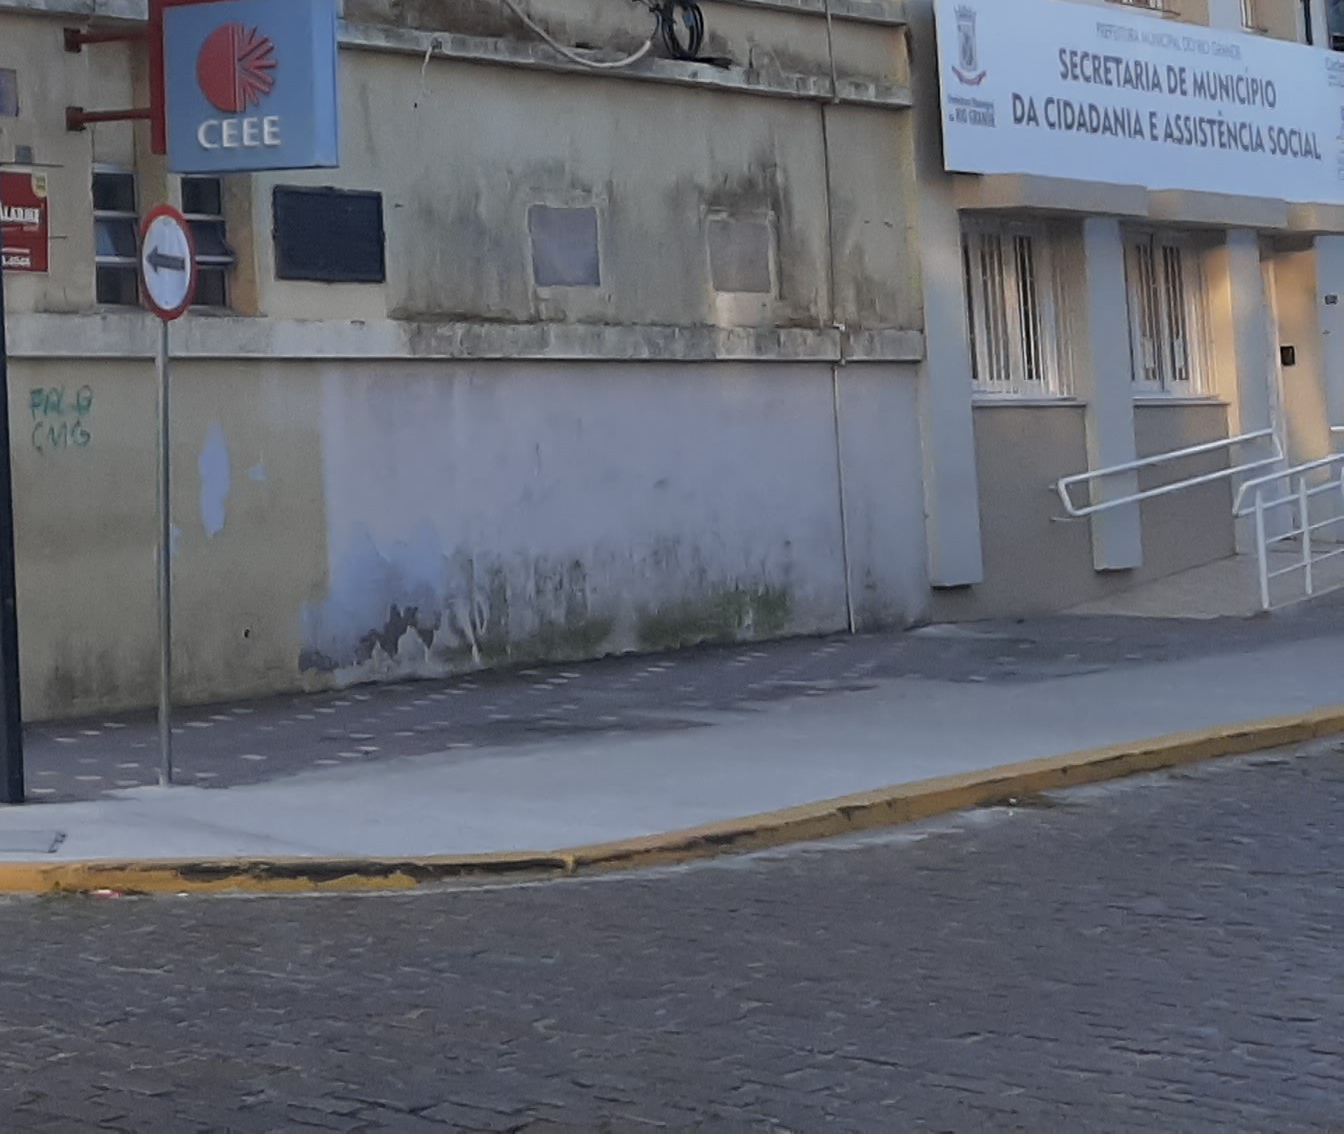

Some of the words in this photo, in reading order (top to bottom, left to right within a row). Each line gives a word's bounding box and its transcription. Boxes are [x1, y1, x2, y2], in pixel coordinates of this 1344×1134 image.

[1058, 47, 1163, 94] SECRETARIA
[1166, 64, 1188, 97] DE
[1193, 67, 1277, 109] MUNICÍPIO
[197, 116, 282, 149] CEEE
[1012, 92, 1040, 127] DA
[1044, 96, 1144, 140] CIDADANIA
[1149, 111, 1158, 142] E
[1163, 110, 1265, 154] ASSISTÊNCIA
[1268, 125, 1322, 161] SOCIAL
